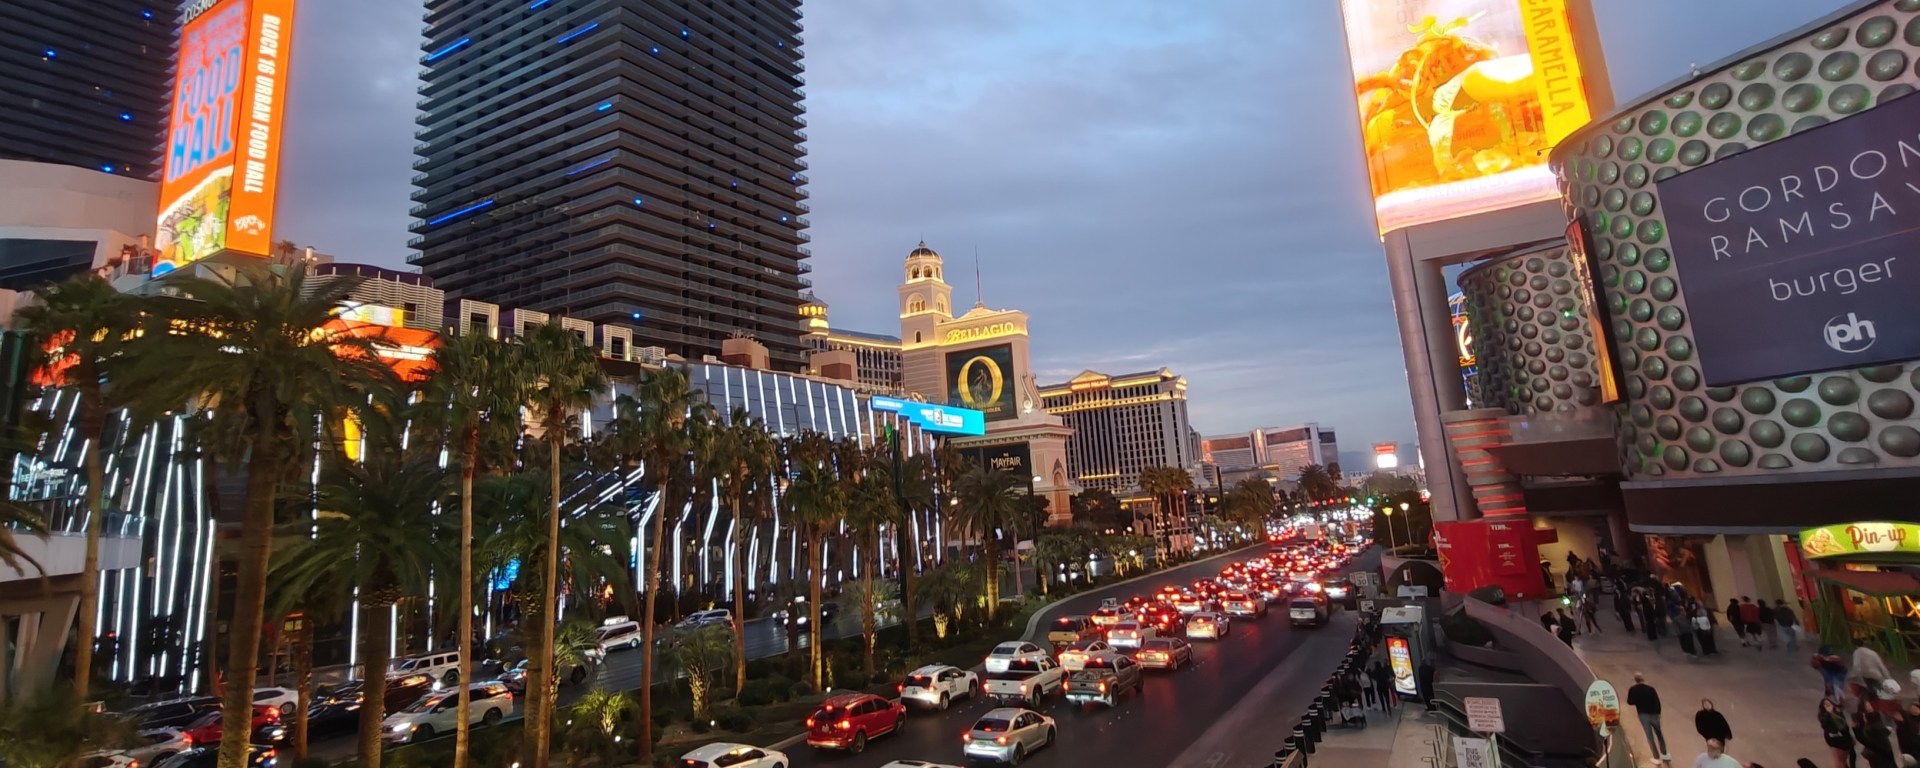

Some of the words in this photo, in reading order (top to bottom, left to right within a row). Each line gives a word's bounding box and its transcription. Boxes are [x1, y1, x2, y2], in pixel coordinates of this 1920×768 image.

[259, 13, 281, 58] BLOCK
[176, 45, 241, 125] FOOD
[257, 58, 276, 75] 16
[252, 75, 274, 123] URBAN
[168, 96, 234, 184] HALL
[248, 121, 270, 160] FOOD
[244, 159, 266, 194] HALL
[1704, 132, 1920, 222] GORDON
[1769, 257, 1896, 301] burger
[946, 321, 1015, 345] BELLAGIO
[1828, 312, 1876, 350] ph
[990, 456, 1022, 469] MAYFAIR
[1845, 525, 1906, 551] Pin-up
